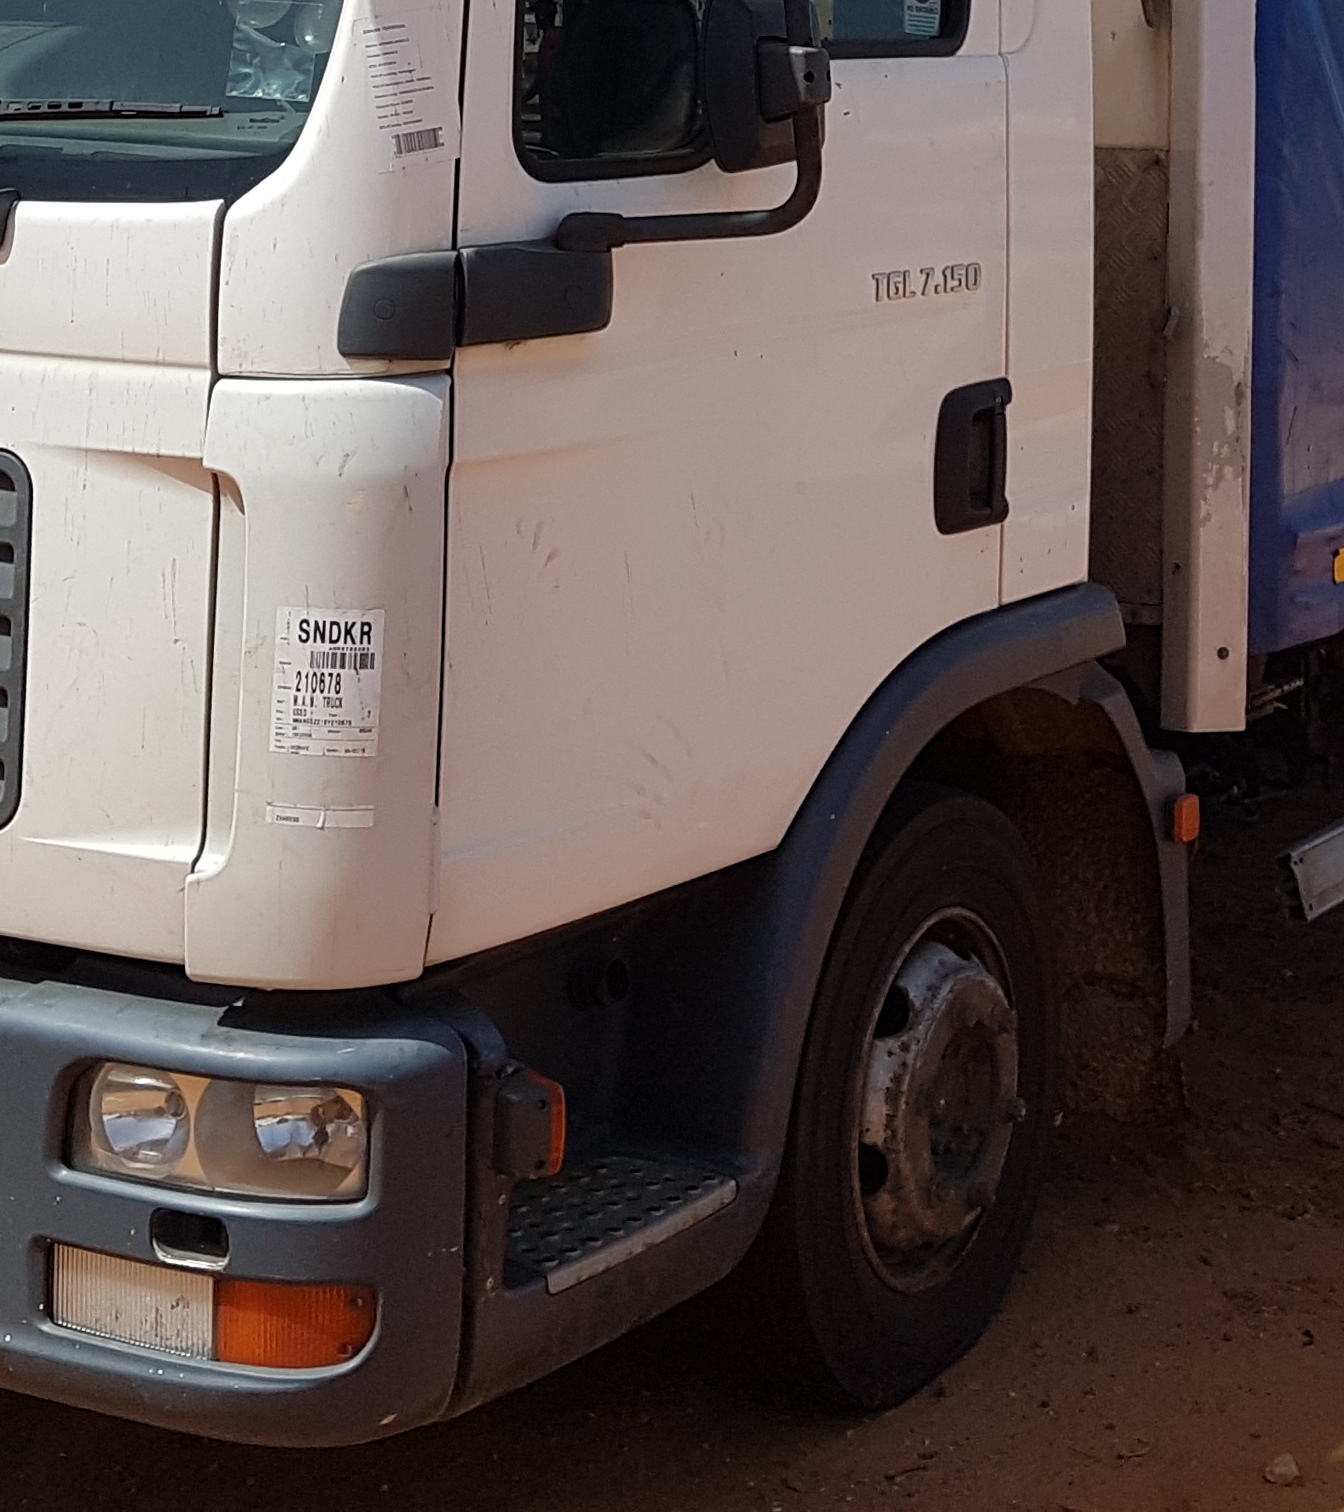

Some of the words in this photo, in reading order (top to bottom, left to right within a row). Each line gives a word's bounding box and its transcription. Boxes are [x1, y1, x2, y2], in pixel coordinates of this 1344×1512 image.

[872, 269, 917, 303] TGL
[919, 262, 982, 297] 7.150
[298, 618, 373, 645] SNDKR
[295, 670, 342, 695] 210678
